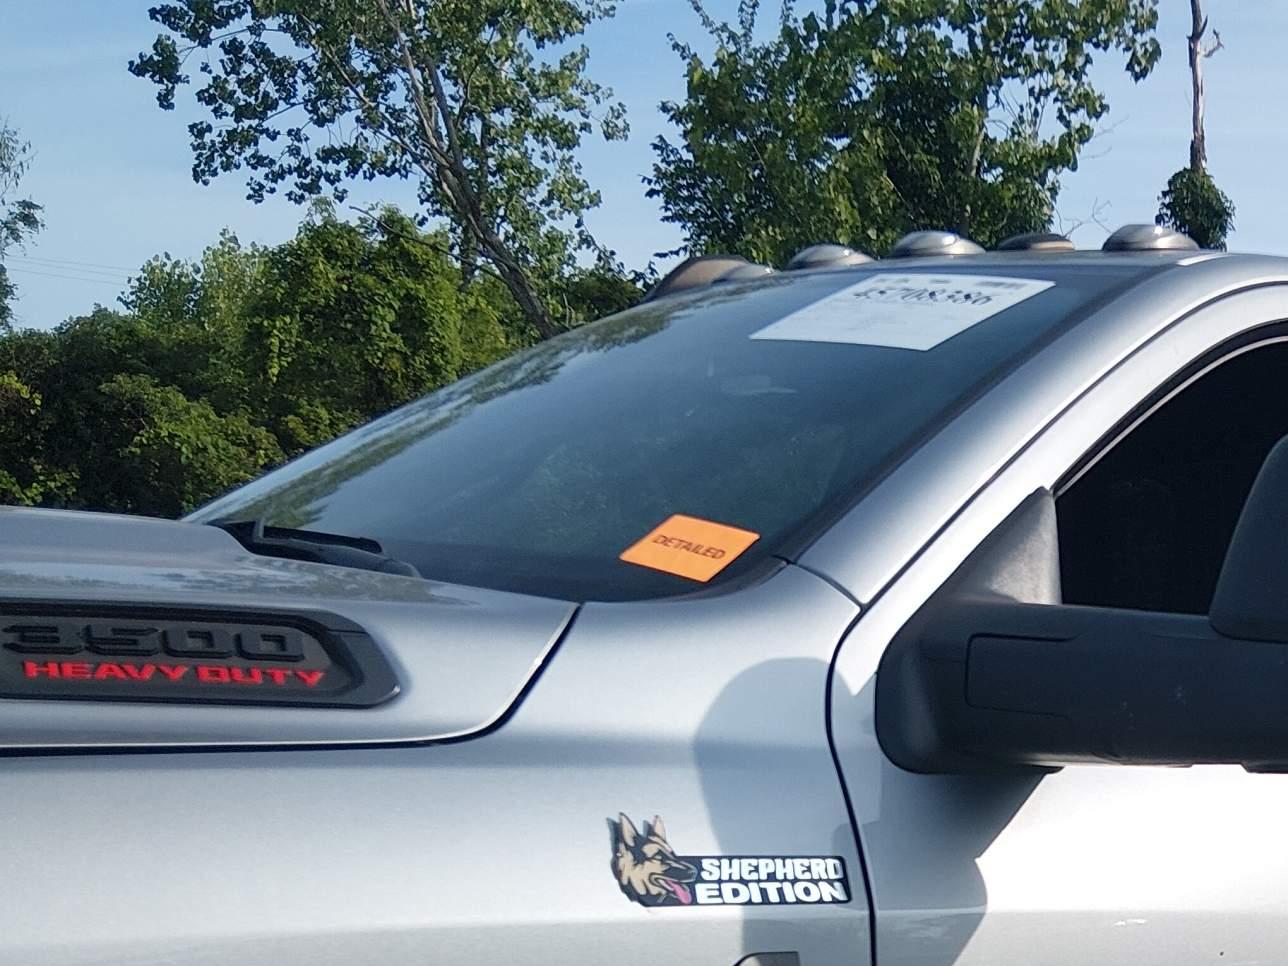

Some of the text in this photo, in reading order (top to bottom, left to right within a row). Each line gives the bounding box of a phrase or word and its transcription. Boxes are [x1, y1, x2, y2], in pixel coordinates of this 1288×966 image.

[653, 534, 726, 560] DETAILED
[3, 625, 305, 662] 3500
[24, 659, 324, 686] HEAVY DUTY
[700, 858, 844, 881] SHEPHERD
[695, 881, 849, 904] EDITION
